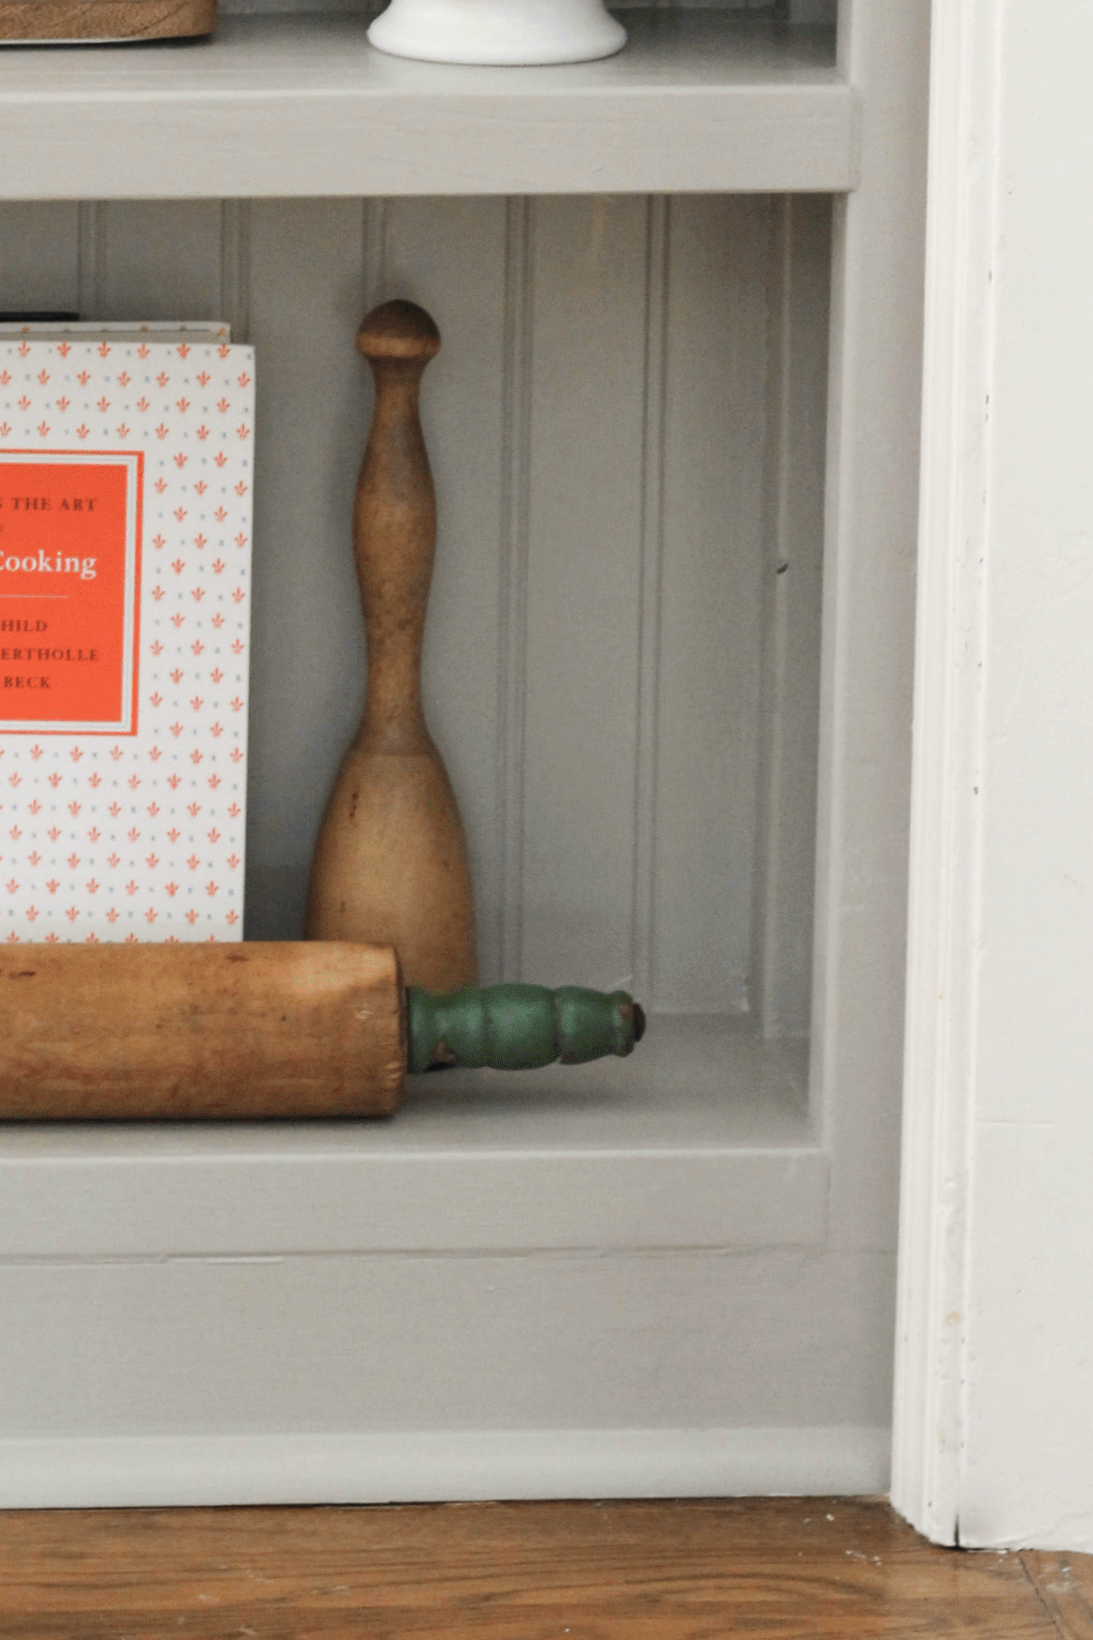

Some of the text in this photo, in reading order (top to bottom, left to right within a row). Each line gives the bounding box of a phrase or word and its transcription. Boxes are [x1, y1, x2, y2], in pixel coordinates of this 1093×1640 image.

[11, 496, 51, 511] THE
[60, 497, 98, 511] ART
[2, 676, 51, 690] BECK
